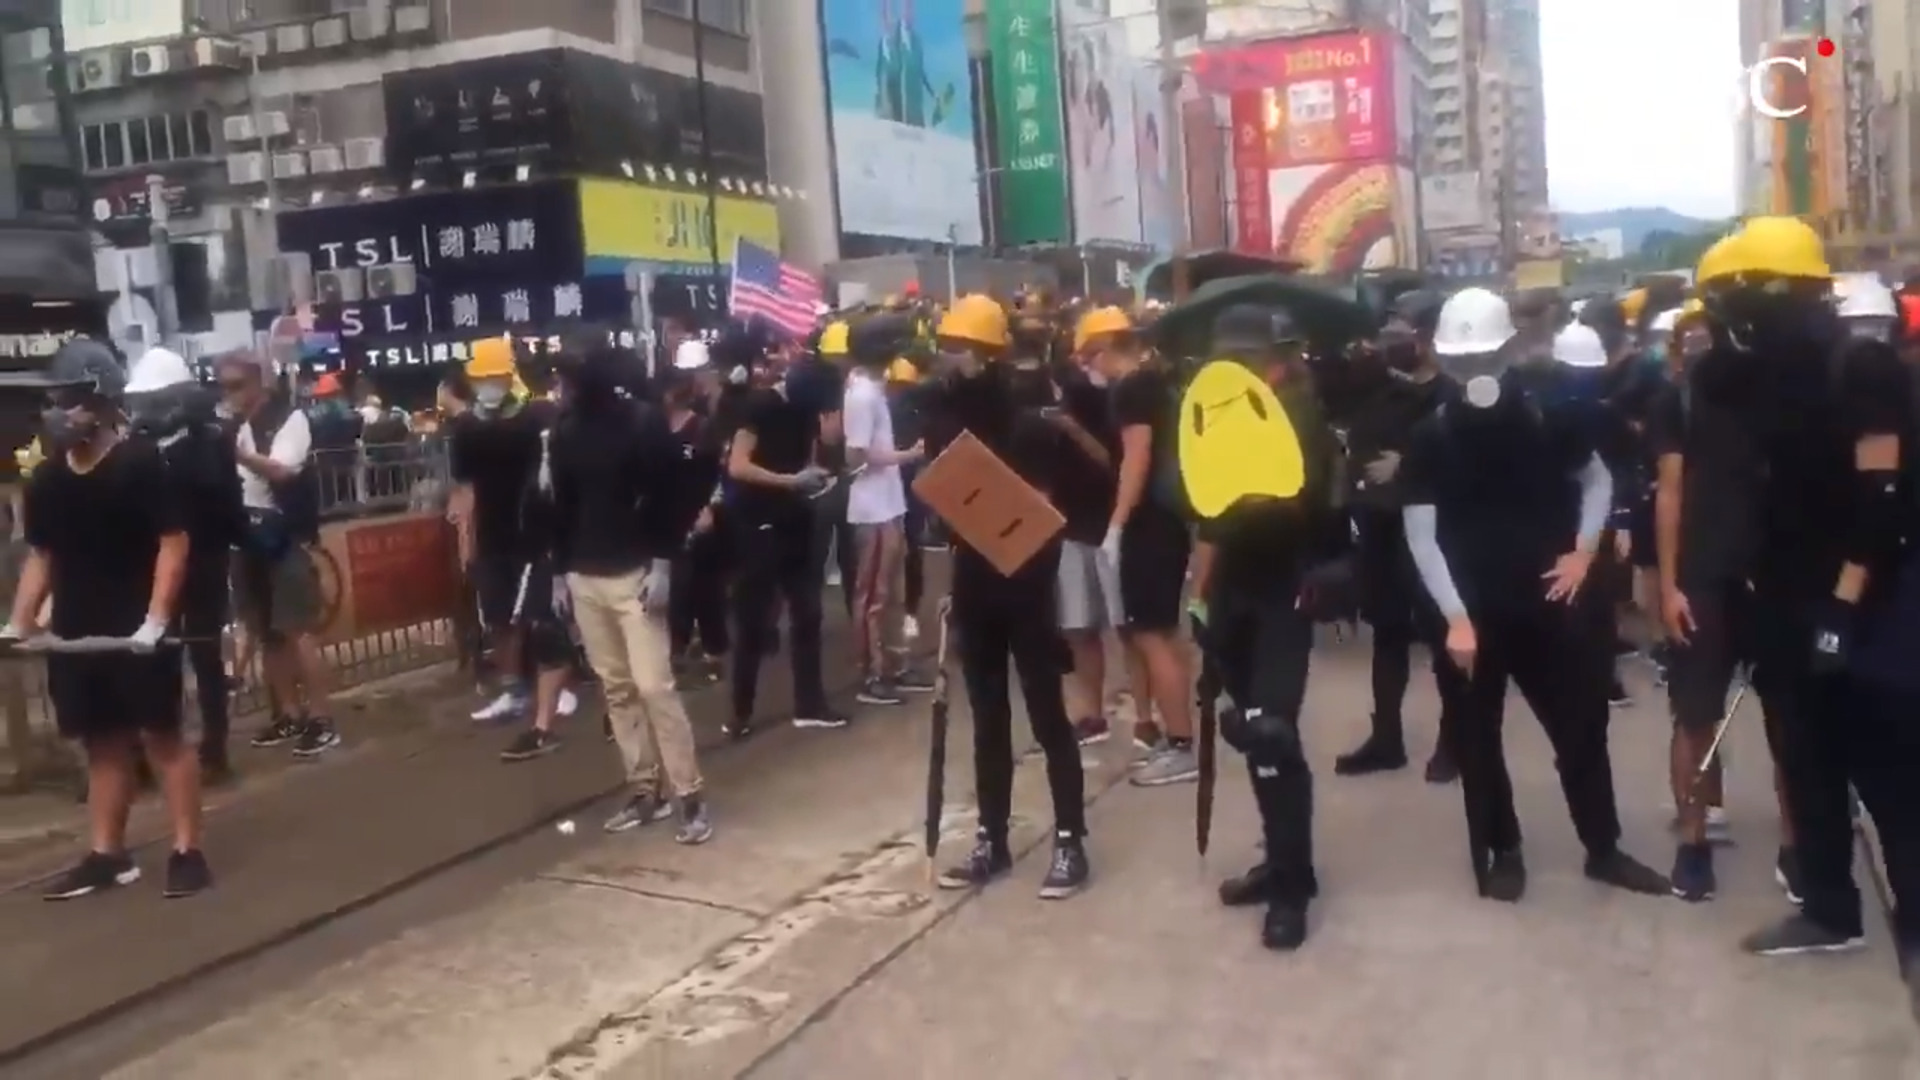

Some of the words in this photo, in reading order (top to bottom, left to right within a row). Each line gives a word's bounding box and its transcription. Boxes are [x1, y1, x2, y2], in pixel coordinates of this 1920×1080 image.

[1326, 37, 1371, 67] No.1
[319, 236, 412, 268] TSL
[366, 345, 420, 366] TSL
